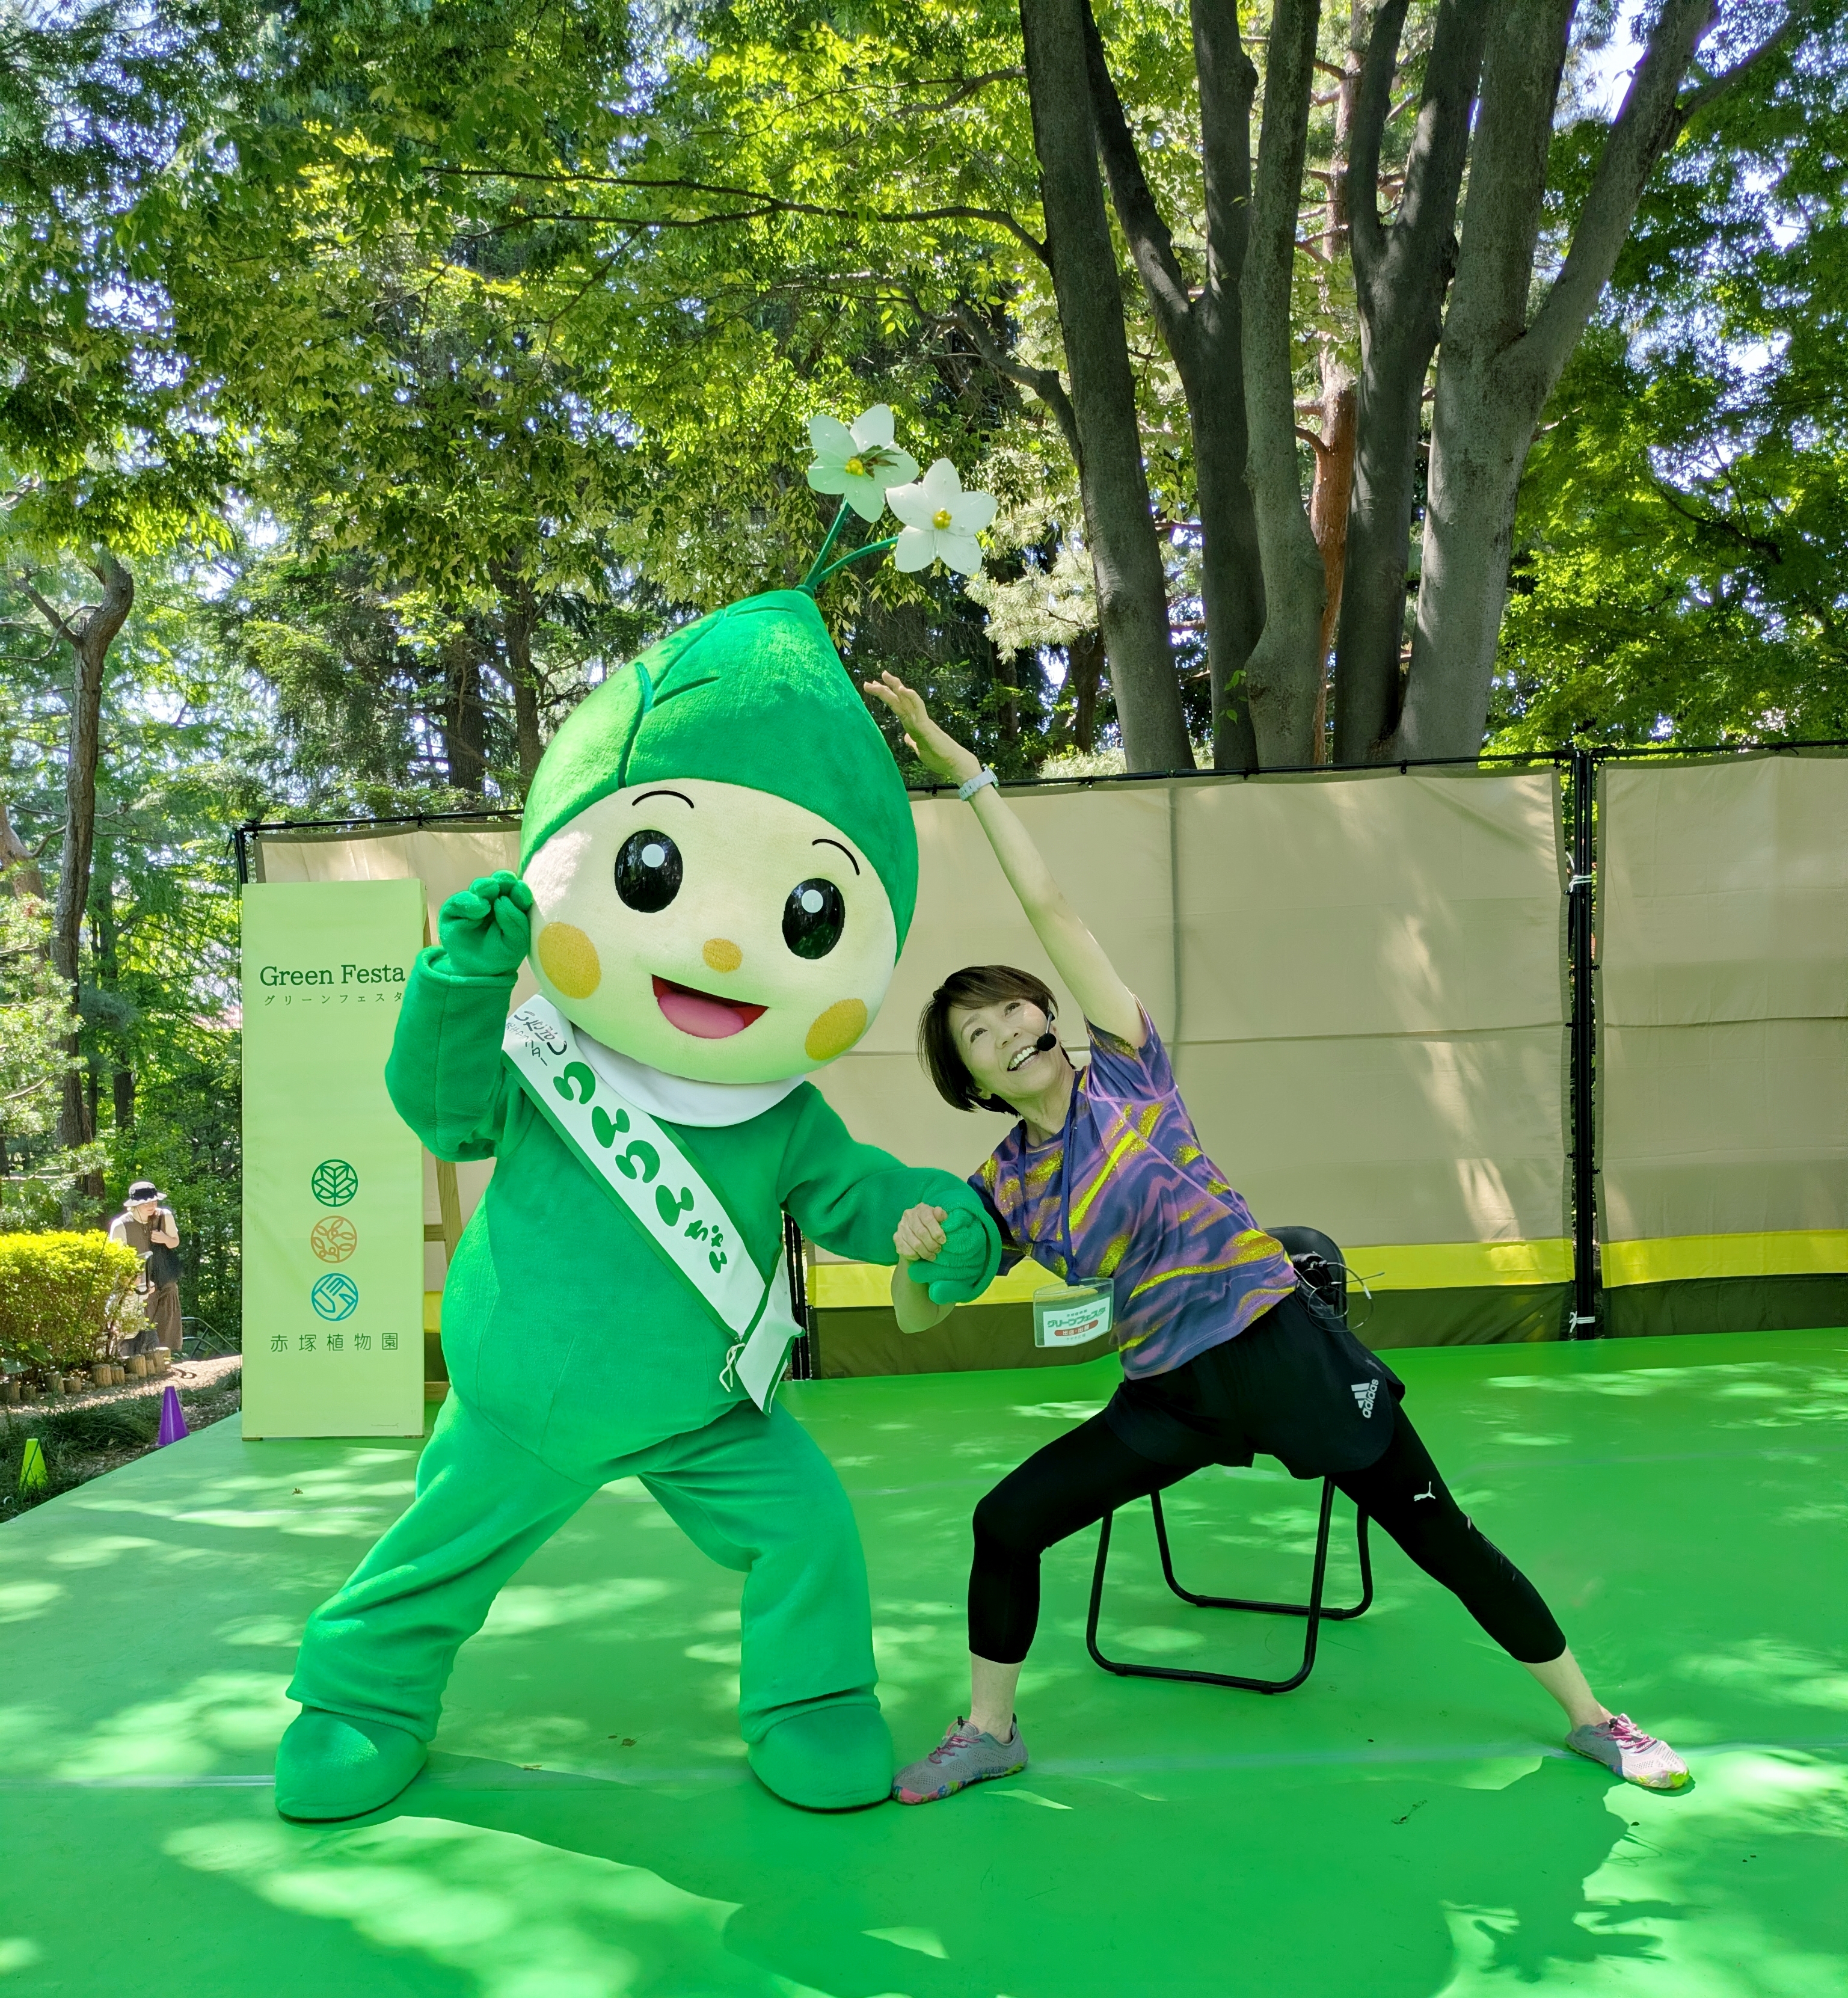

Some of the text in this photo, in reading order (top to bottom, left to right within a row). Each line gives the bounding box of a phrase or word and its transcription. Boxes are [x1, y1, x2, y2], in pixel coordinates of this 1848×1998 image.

[260, 964, 406, 986] Green Festa
[264, 991, 403, 1006] グリーンフェスタ
[514, 1010, 568, 1056] いたばし
[553, 1061, 728, 1274] りんりんちゃん
[270, 1332, 399, 1353] 赤塚植物園
[1362, 1379, 1379, 1418] adidas
